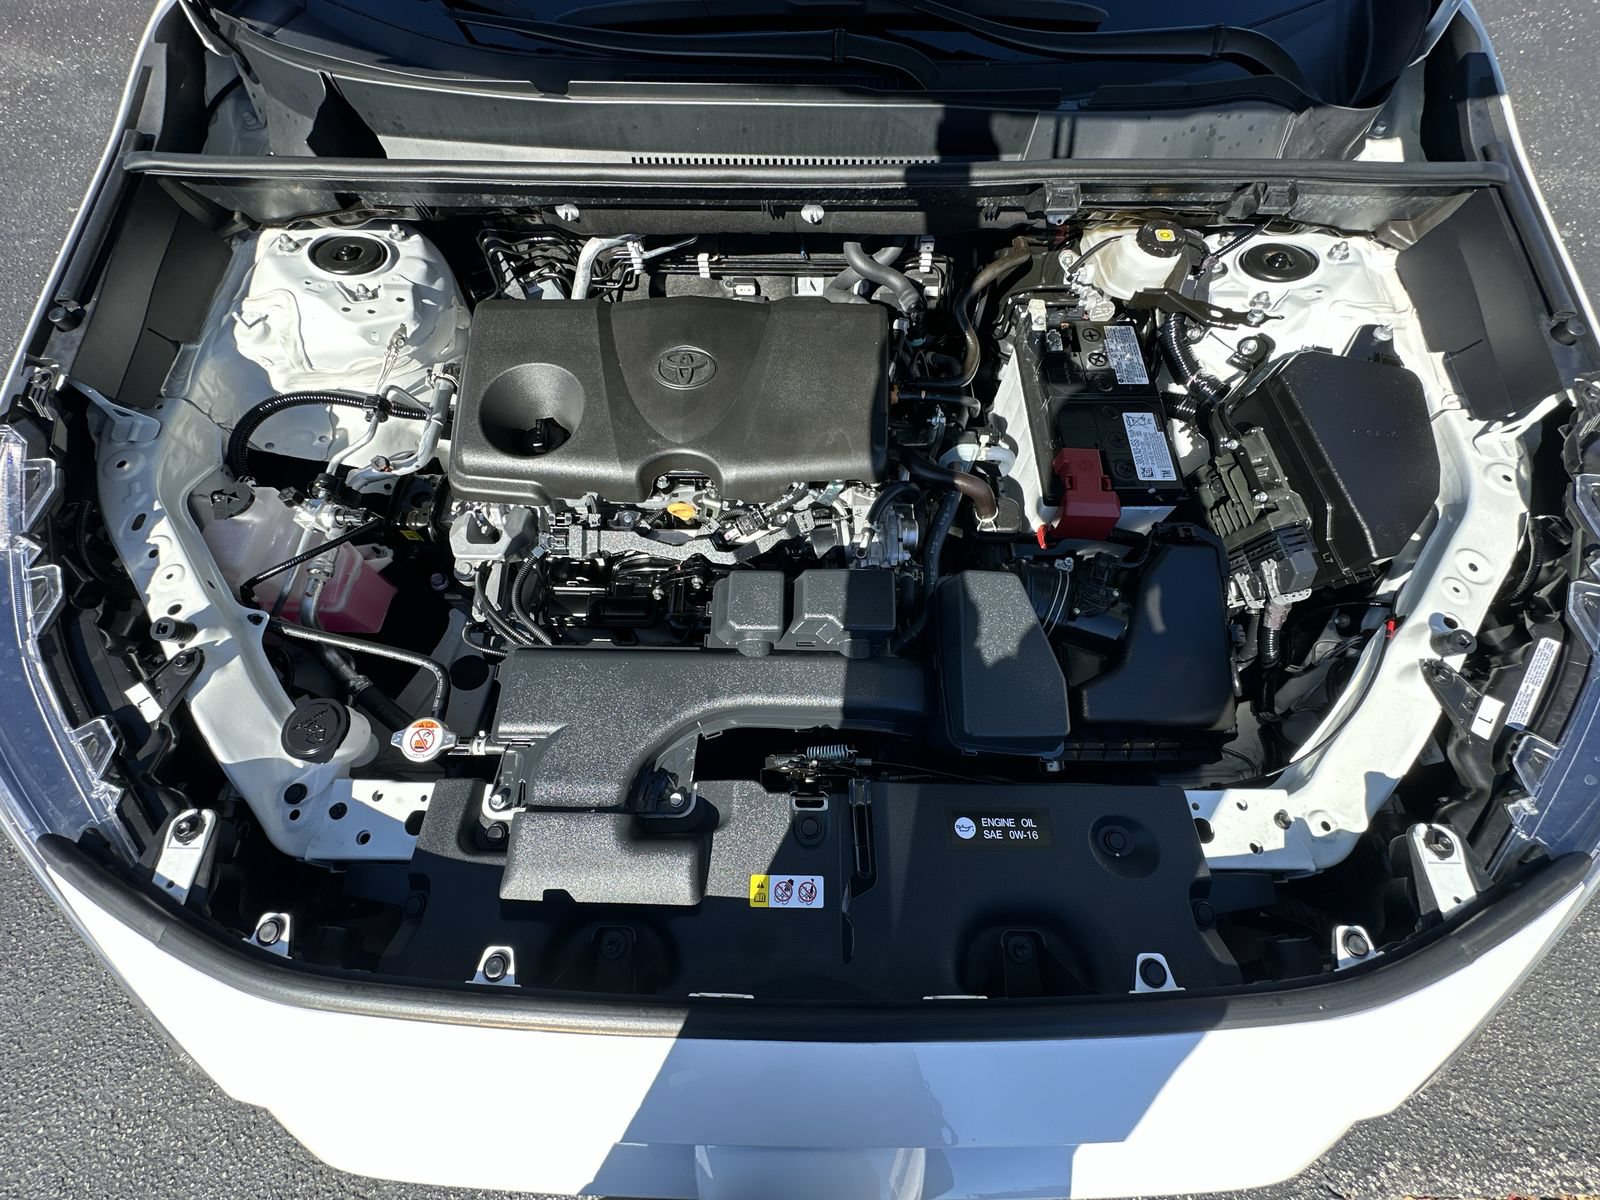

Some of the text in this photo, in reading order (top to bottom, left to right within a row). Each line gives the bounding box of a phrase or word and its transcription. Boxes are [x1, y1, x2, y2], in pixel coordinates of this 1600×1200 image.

[1478, 715, 1494, 725] L
[981, 818, 1037, 828] ENGINE OIL
[983, 830, 1039, 840] SAE 0W-16
